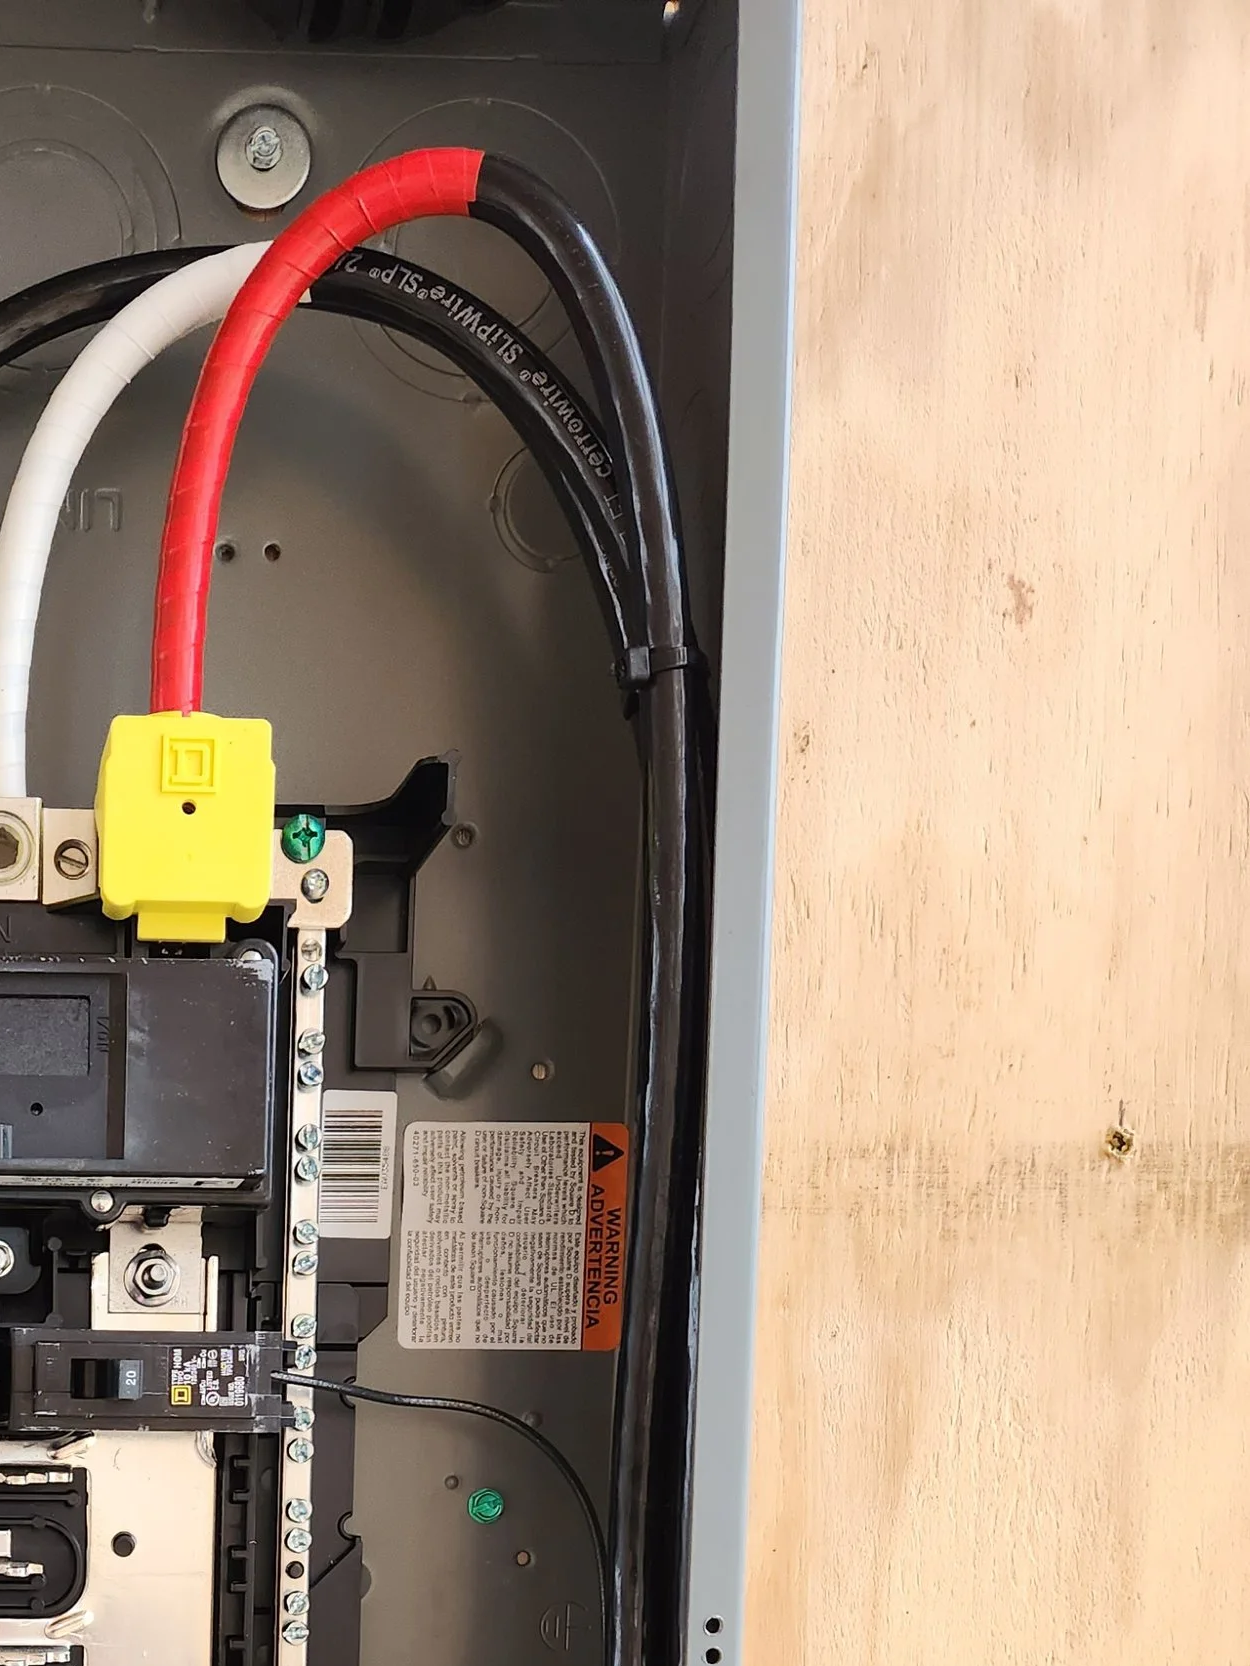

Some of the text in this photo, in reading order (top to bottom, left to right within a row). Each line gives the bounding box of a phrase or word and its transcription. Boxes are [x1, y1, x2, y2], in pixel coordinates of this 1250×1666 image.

[585, 1183, 606, 1329] ADVERTENCIA
[602, 1207, 622, 1306] WARNING
[173, 1349, 182, 1369] HOM
[125, 1370, 137, 1386] 20
[183, 1374, 190, 1385] 10
